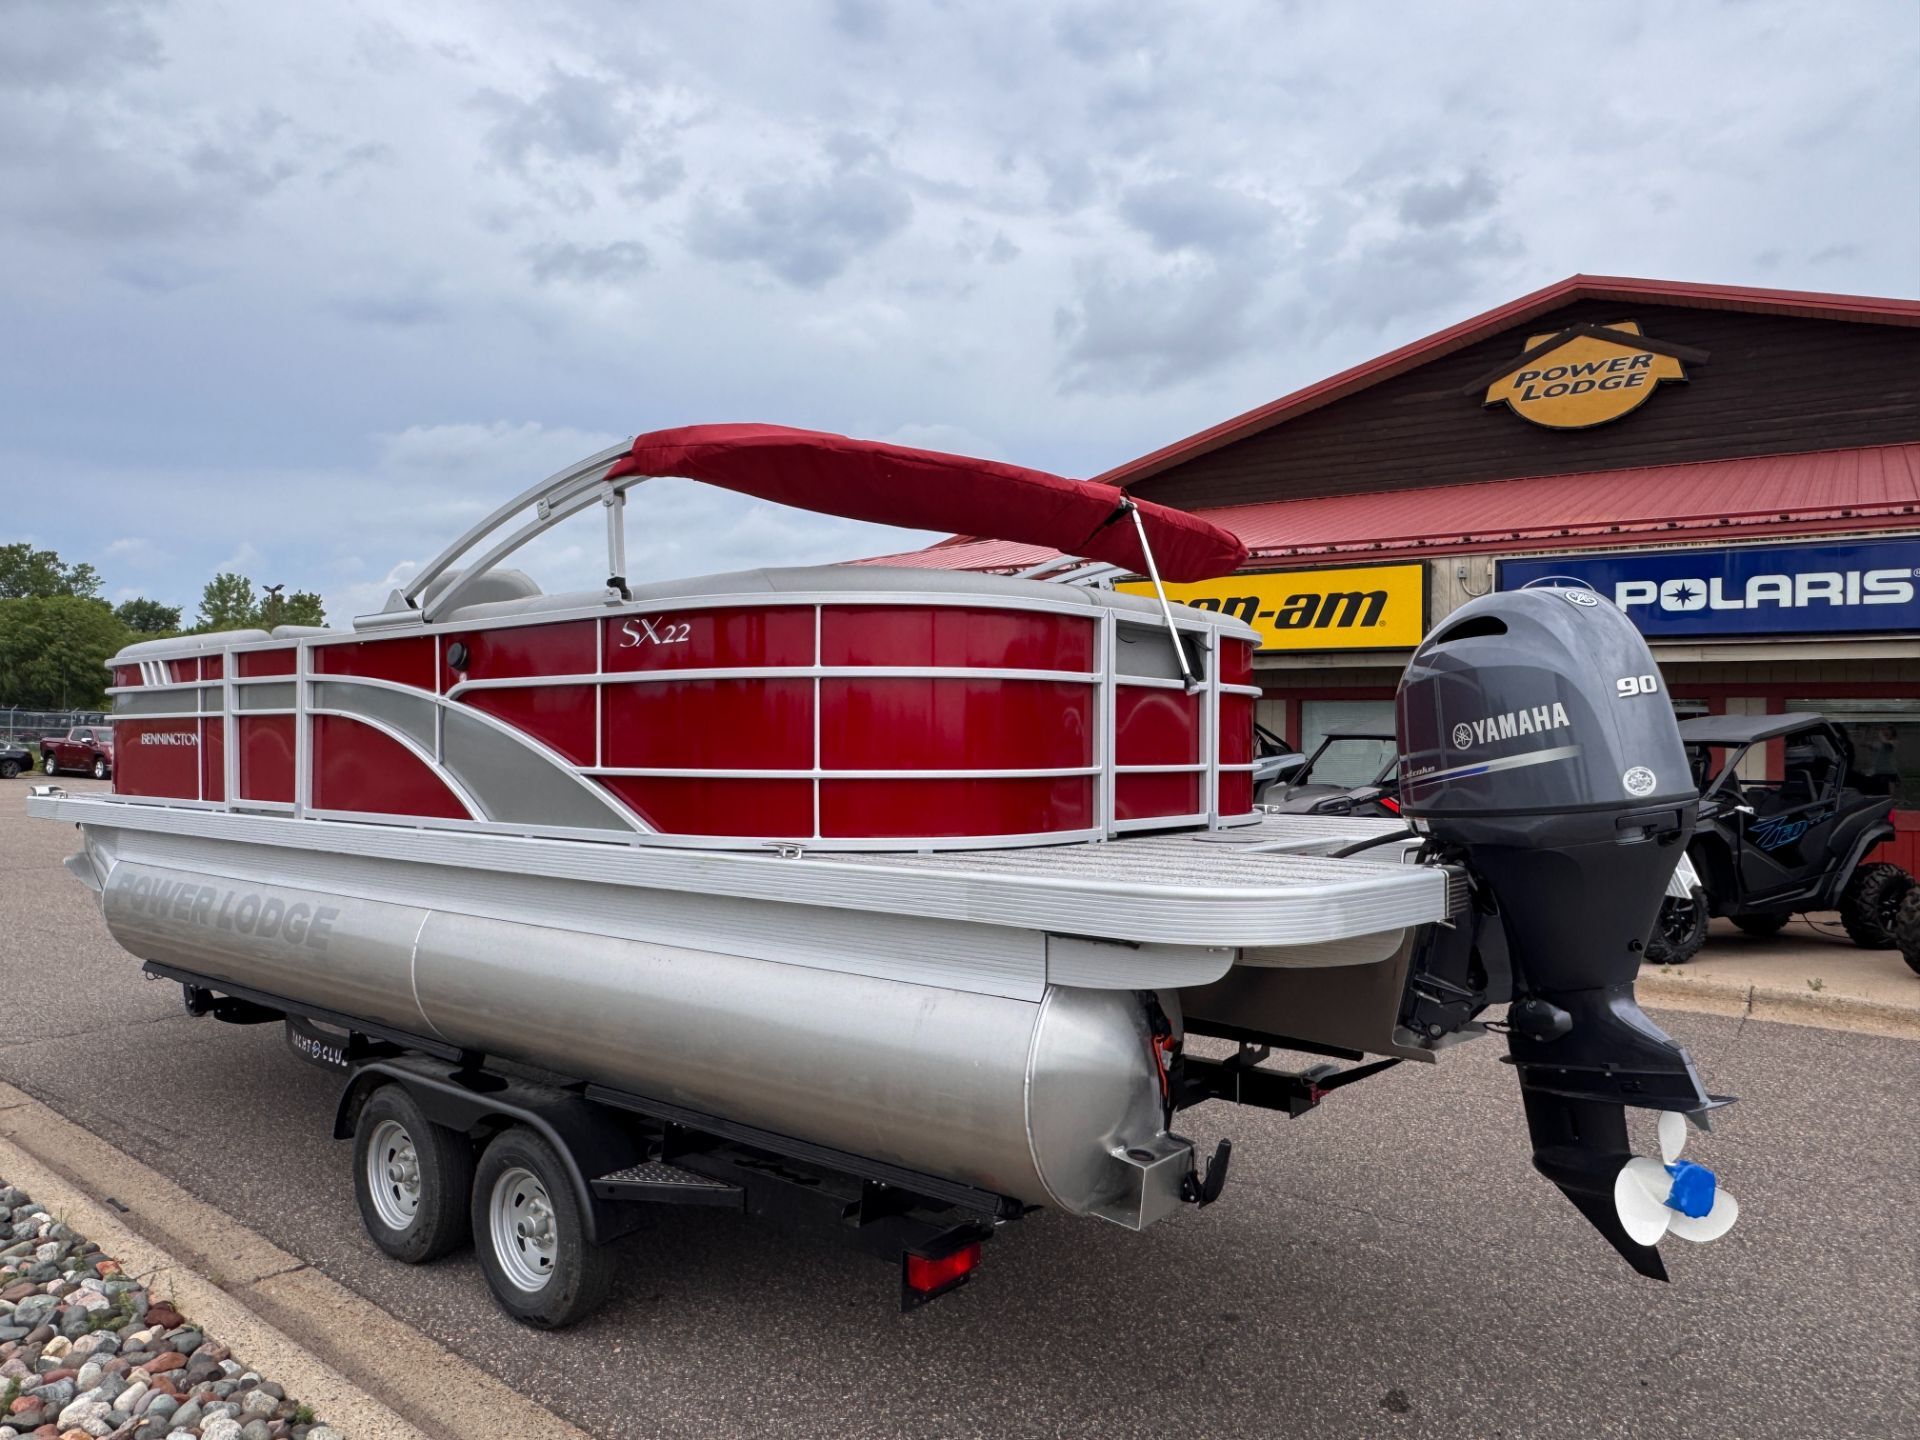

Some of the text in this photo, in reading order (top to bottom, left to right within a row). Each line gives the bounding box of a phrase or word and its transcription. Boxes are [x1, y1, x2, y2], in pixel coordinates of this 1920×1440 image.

[1513, 353, 1654, 389] POWER
[1520, 371, 1648, 402] LODGE
[1615, 568, 1914, 613] POLARIS
[1168, 590, 1388, 630] n-am
[1616, 674, 1659, 698] 90
[141, 732, 199, 746] BENNINGTON
[1472, 702, 1570, 744] YAMAHA
[113, 872, 340, 951] POWER LODGE
